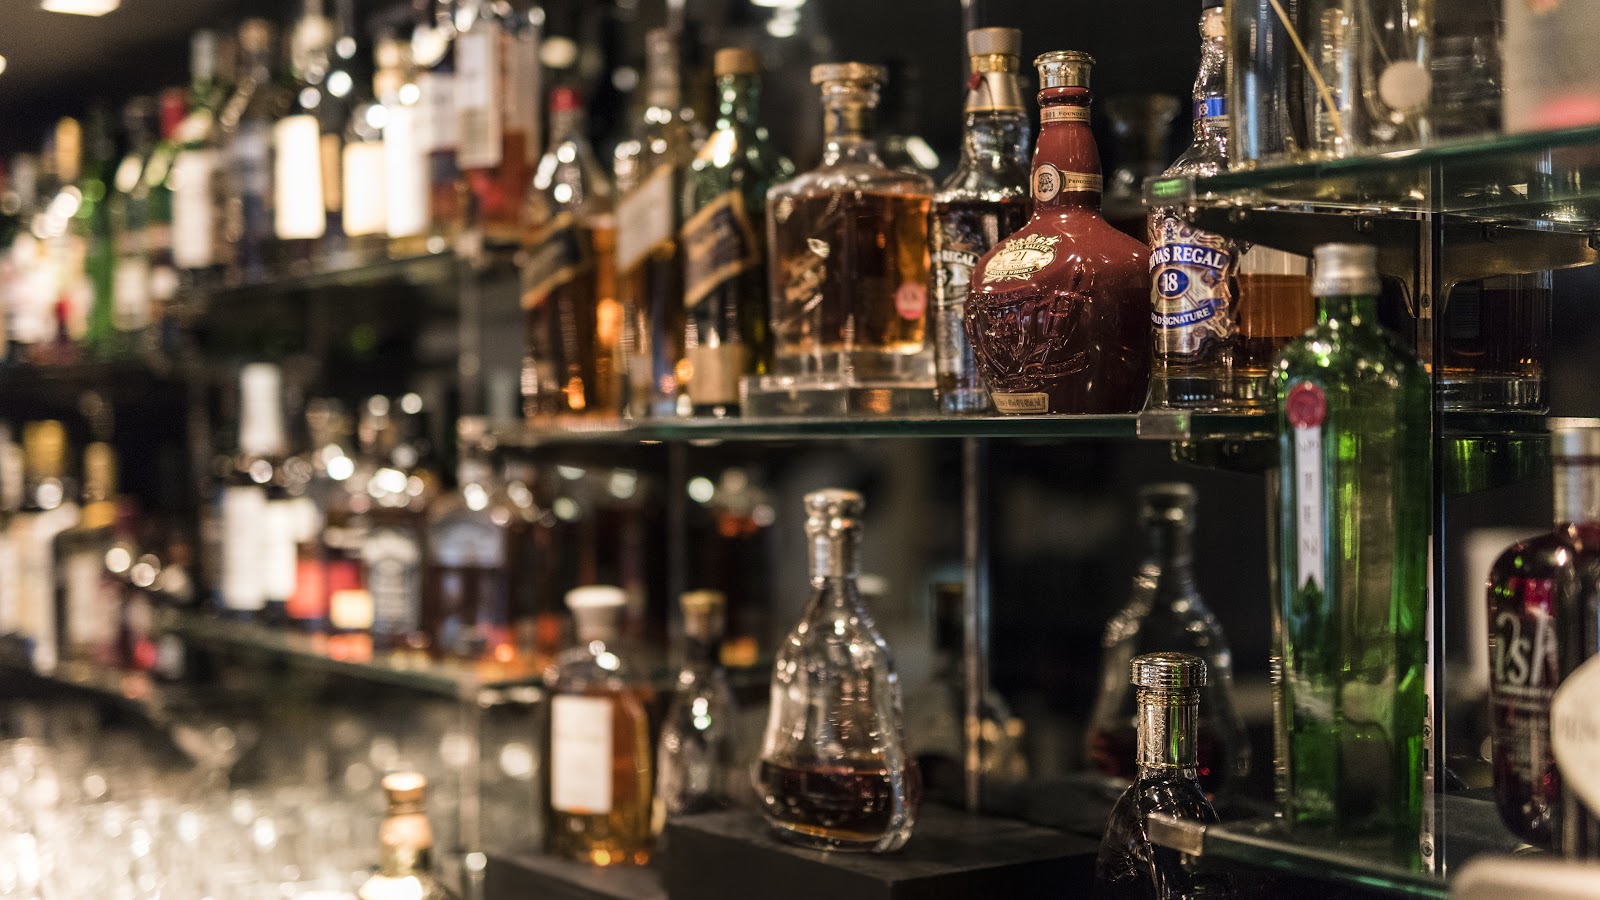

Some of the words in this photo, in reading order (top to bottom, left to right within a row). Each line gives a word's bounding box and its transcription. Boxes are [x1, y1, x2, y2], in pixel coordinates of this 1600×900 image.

[1010, 251, 1028, 261] 21
[1025, 243, 1048, 252] SALUTE
[1149, 247, 1170, 273] HIVAS
[1173, 246, 1224, 269] REGAL
[1163, 272, 1179, 292] 18
[1162, 307, 1211, 326] SIGNATURE
